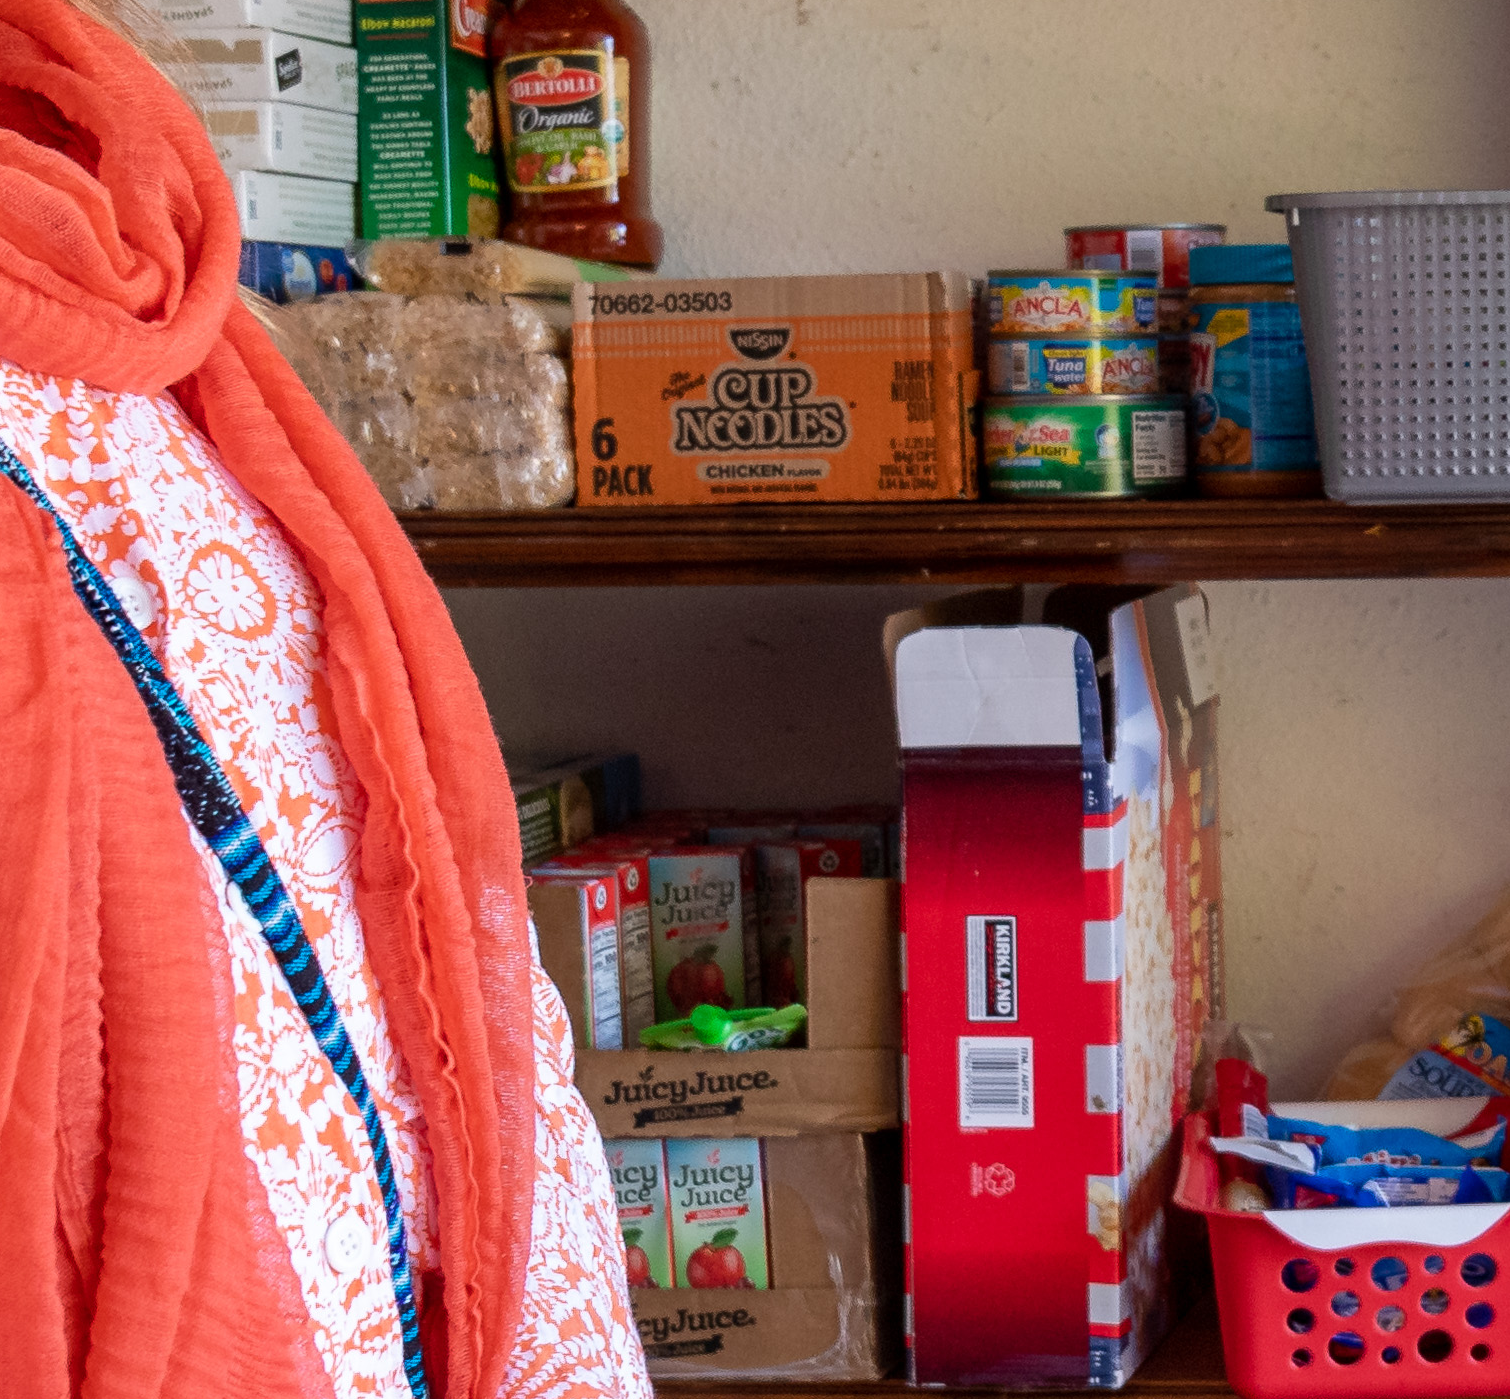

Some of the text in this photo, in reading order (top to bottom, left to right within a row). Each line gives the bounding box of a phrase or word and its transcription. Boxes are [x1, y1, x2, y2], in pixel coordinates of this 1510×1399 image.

[512, 77, 596, 99] BERTOLLI
[518, 106, 594, 133] Organic
[589, 291, 733, 316] 70662-03503
[1013, 295, 1083, 318] ANCLA
[1048, 358, 1084, 372] Tuna
[715, 370, 811, 409] CUP
[592, 417, 618, 461] 6
[677, 405, 846, 449] NOODLES
[1040, 425, 1070, 442] Sea
[1034, 445, 1068, 457] LIGHT
[593, 464, 654, 498] PACK
[706, 464, 784, 479] CHICKEN
[654, 880, 735, 906] Juicy
[661, 902, 728, 926] Juice
[996, 923, 1011, 1015] KIRKLAND
[604, 1080, 689, 1104] Juicy
[673, 1164, 754, 1188] Juicy
[681, 1186, 747, 1207] Juice
